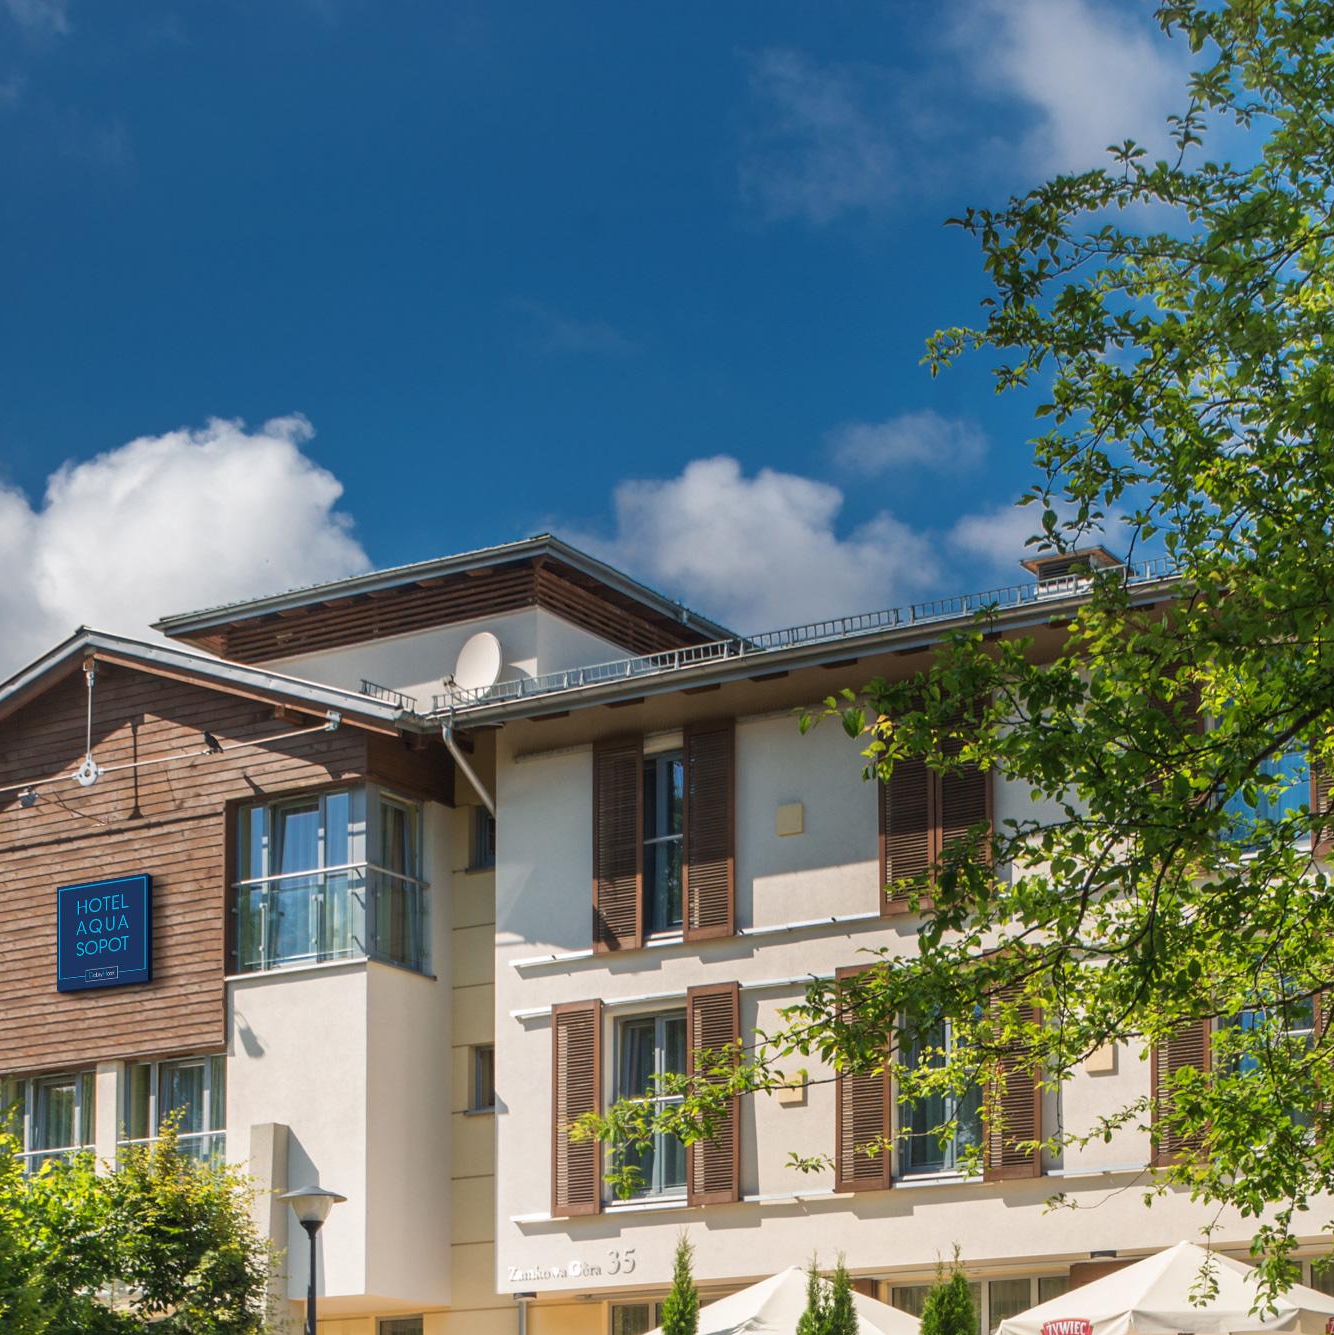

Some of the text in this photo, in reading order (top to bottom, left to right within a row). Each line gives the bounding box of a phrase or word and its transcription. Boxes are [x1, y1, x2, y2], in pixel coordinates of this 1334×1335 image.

[76, 894, 130, 916] HOTEL
[76, 914, 130, 936] AQUA
[76, 935, 130, 957] SOPOT
[607, 1247, 636, 1276] 35
